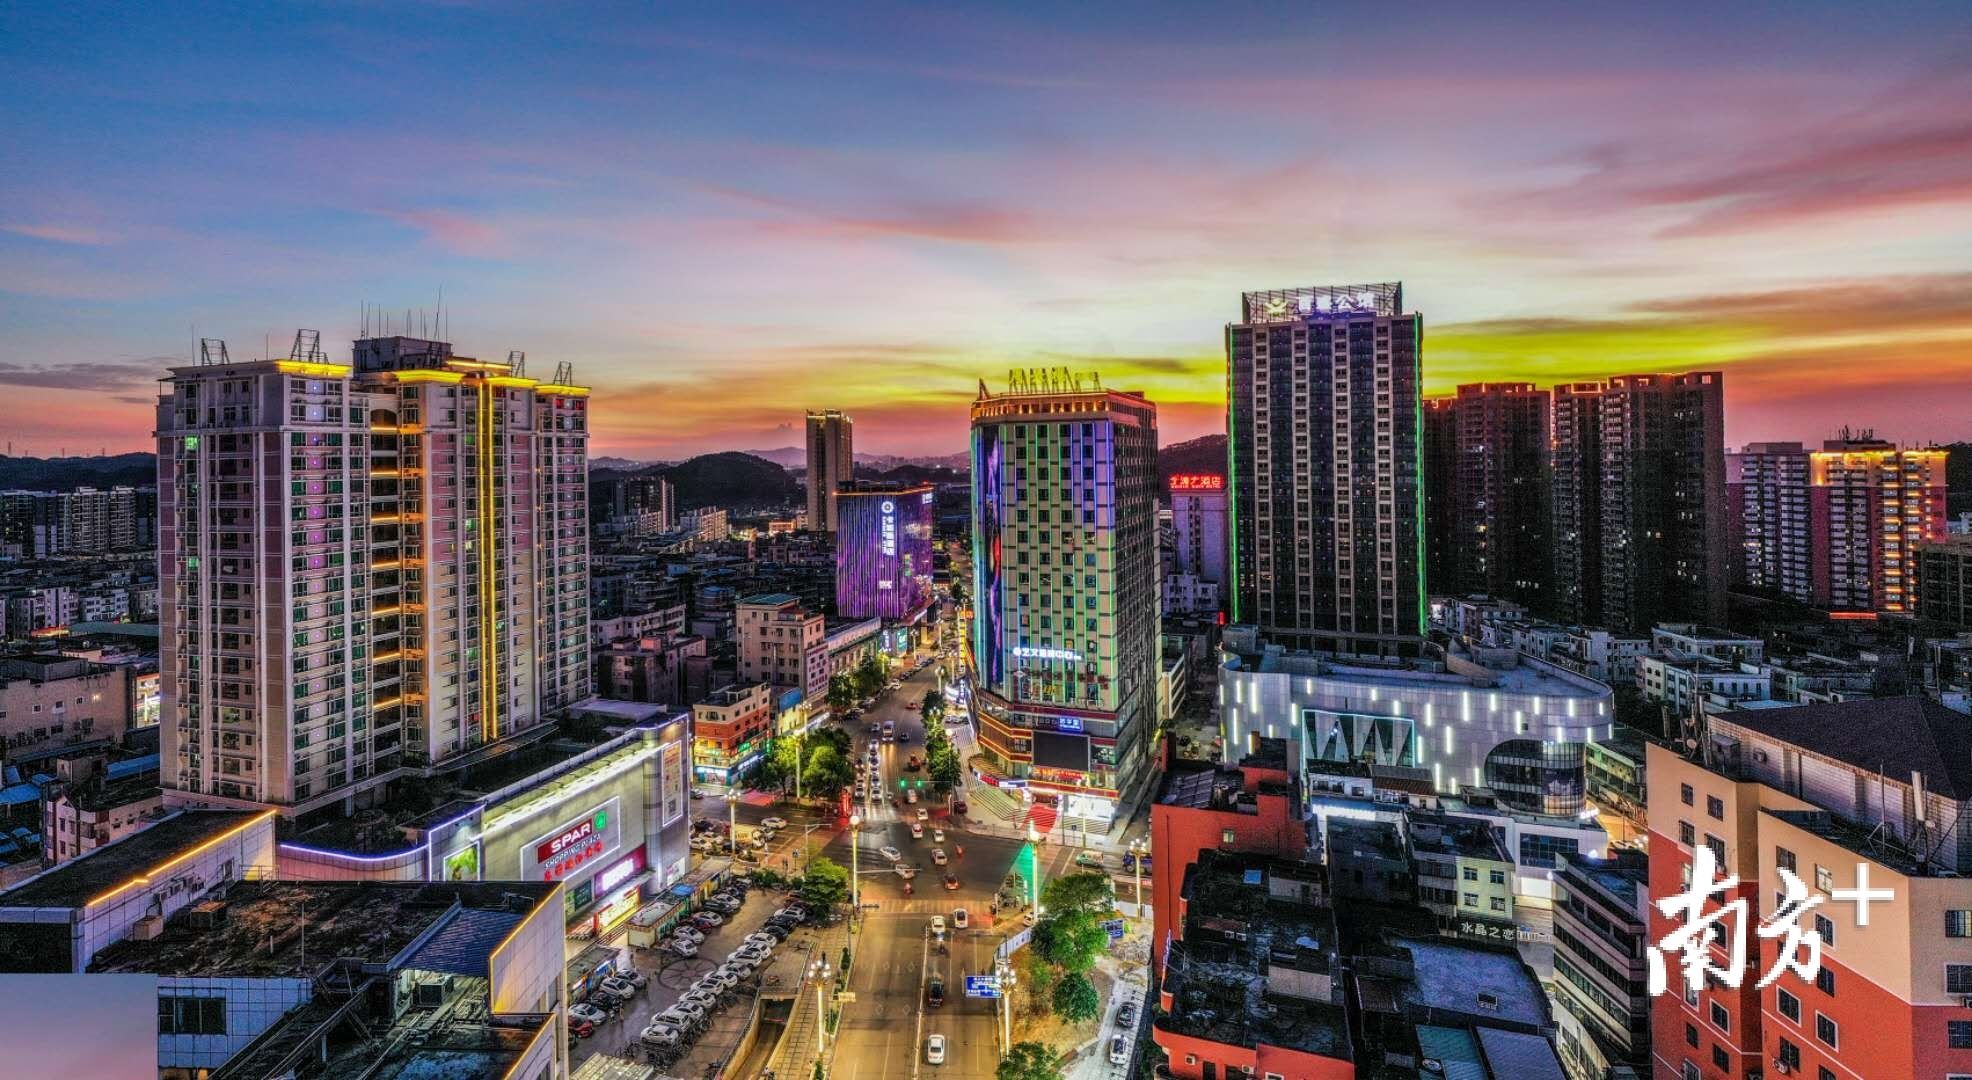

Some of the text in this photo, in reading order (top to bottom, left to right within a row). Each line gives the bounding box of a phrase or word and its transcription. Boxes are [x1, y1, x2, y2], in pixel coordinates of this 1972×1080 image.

[551, 822, 591, 854] SPAR
[1461, 922, 1516, 940] 水晶之恋
